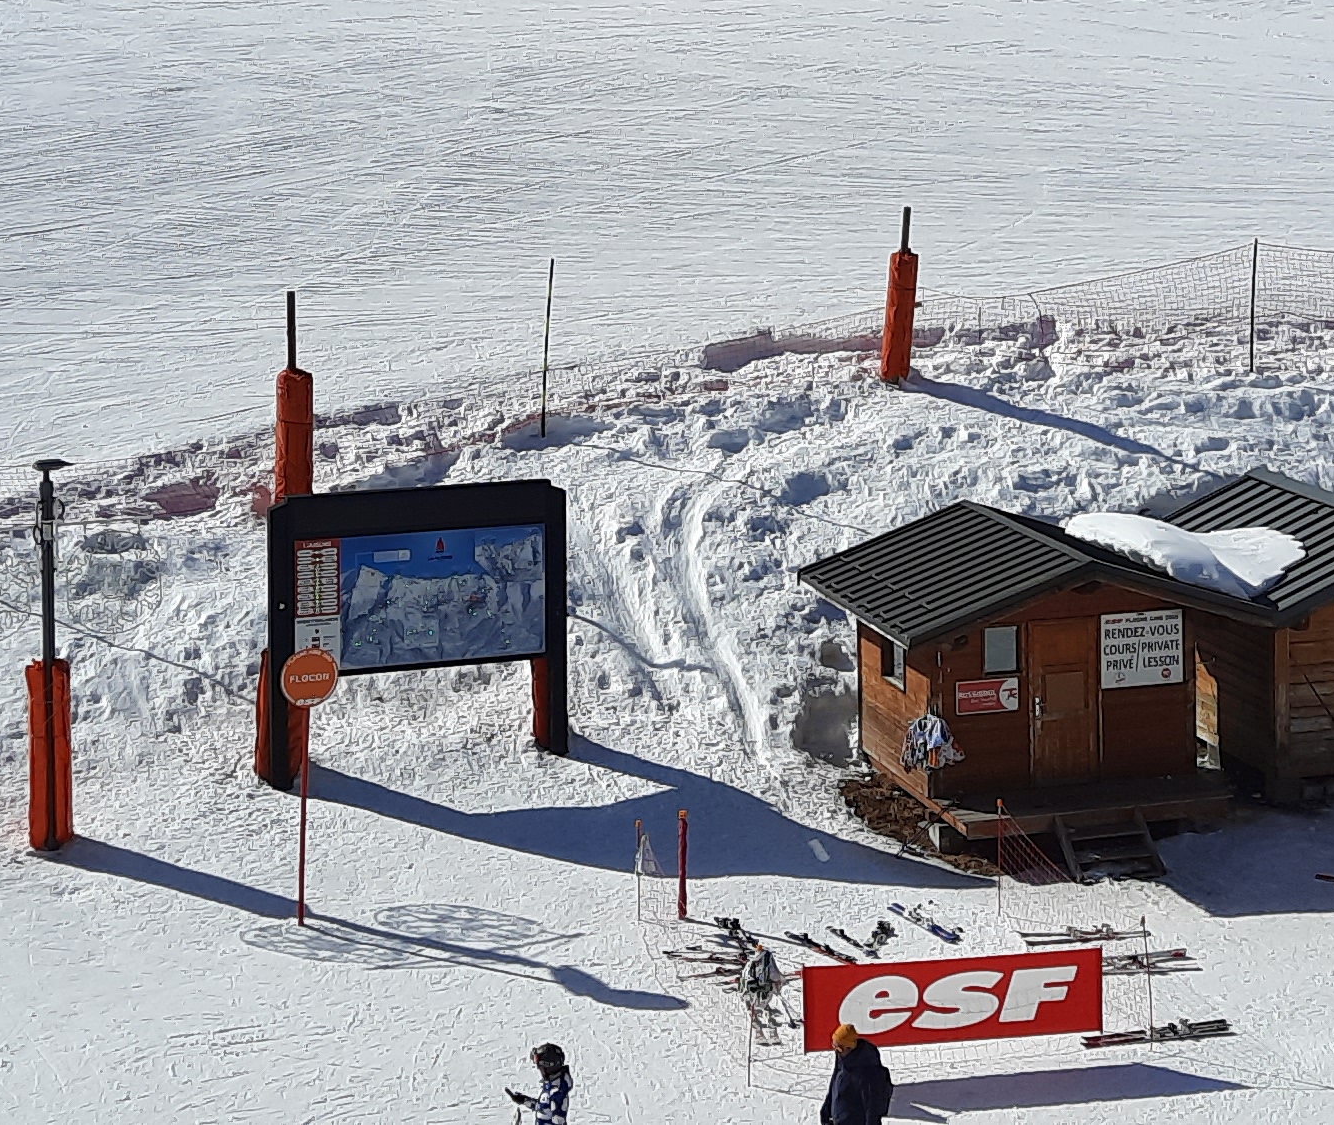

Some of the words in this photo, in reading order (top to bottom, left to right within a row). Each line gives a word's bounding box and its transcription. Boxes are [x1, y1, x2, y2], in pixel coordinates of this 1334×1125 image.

[1104, 623, 1180, 641] RENDEZ-VOUS
[1103, 642, 1137, 656] COURS
[1141, 639, 1180, 653] PRIVATE
[1142, 655, 1180, 669] LESSON
[289, 672, 330, 684] FLOCON
[838, 965, 1079, 1035] esf
